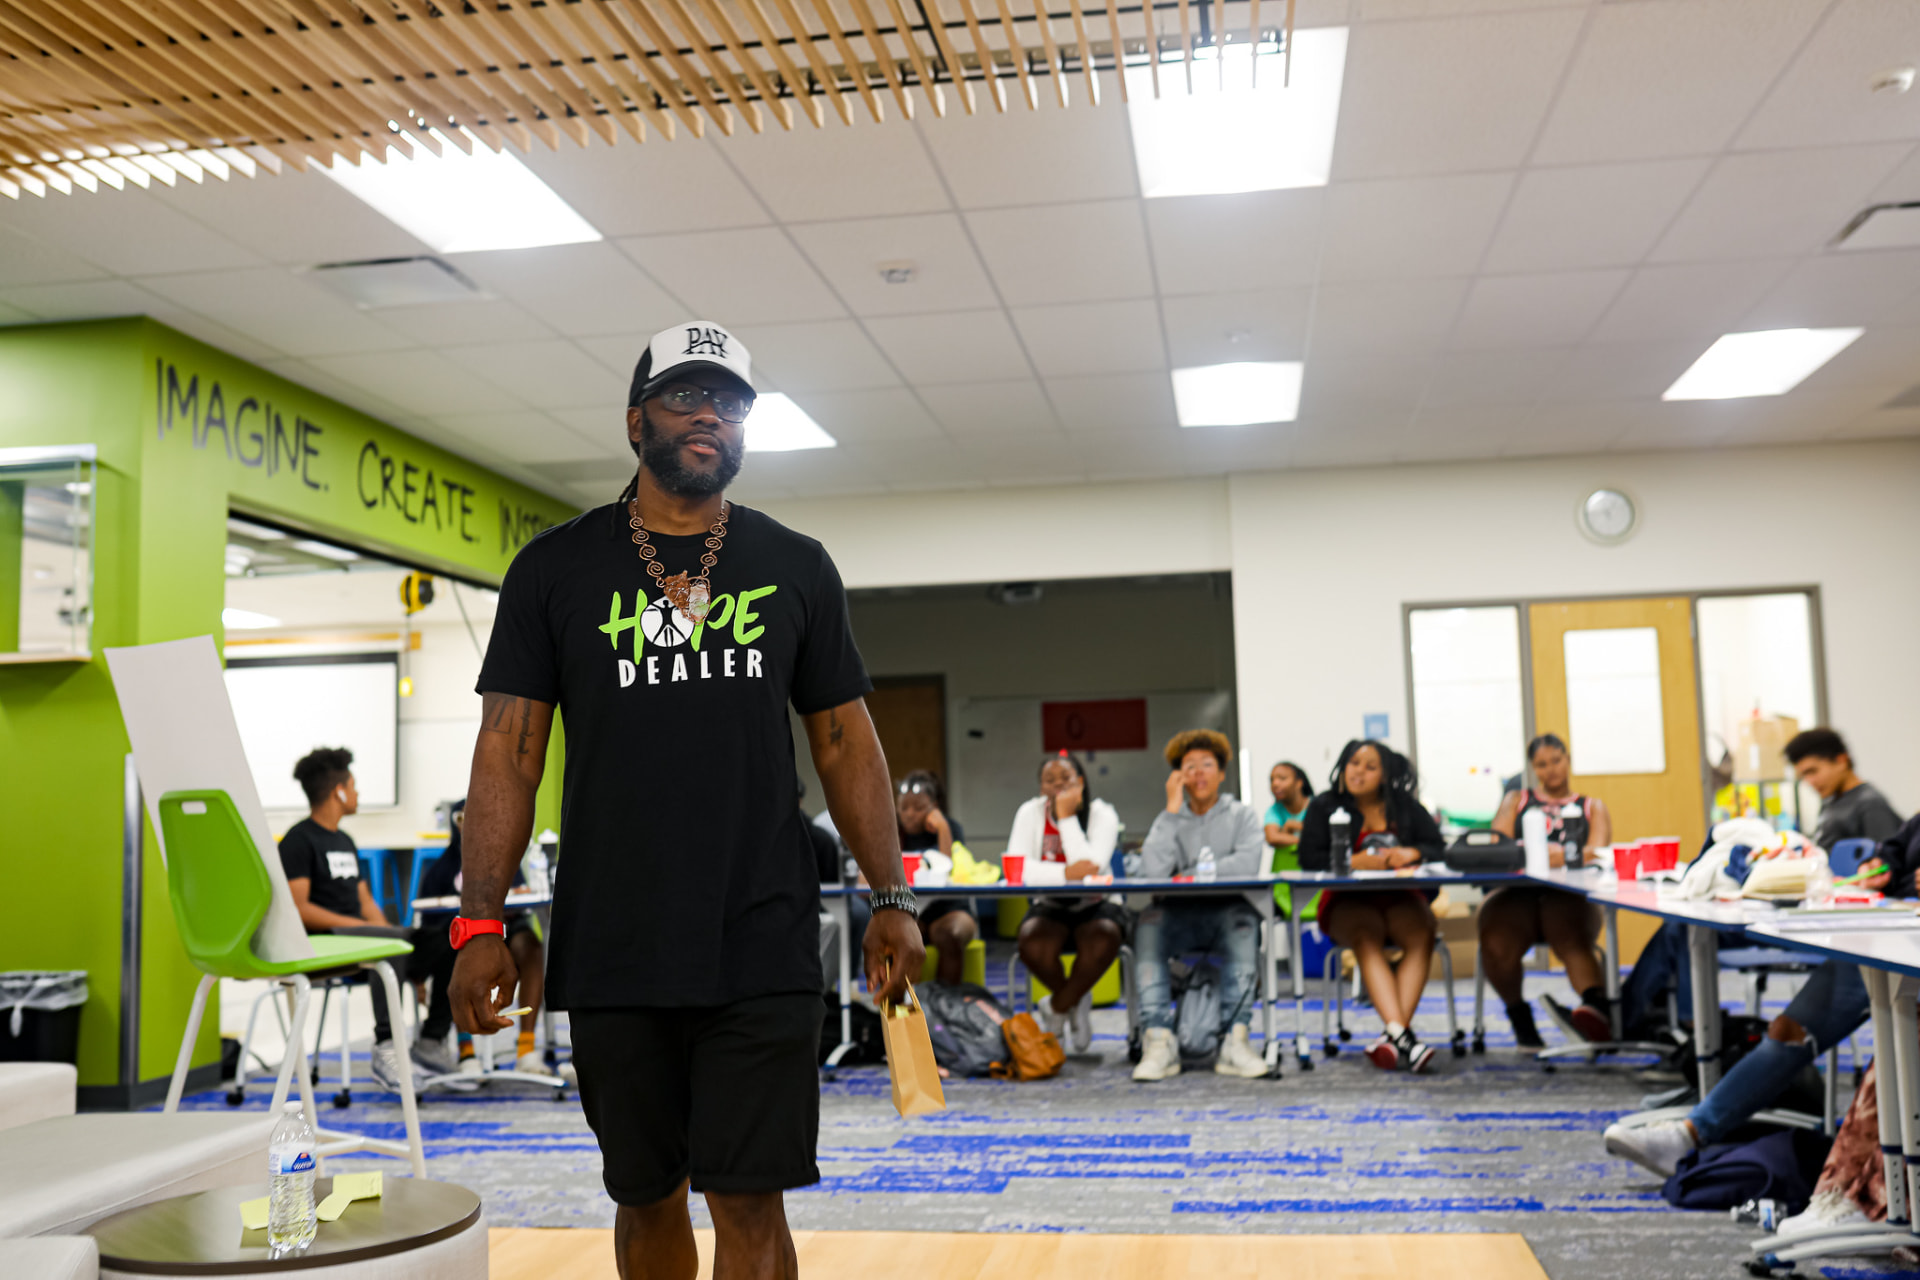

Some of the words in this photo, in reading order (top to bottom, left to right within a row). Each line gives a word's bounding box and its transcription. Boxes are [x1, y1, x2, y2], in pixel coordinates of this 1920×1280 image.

[682, 327, 729, 359] PAY
[156, 357, 329, 493] IMAGINE.
[357, 439, 480, 543] CREATE.
[617, 648, 763, 688] DEALER
